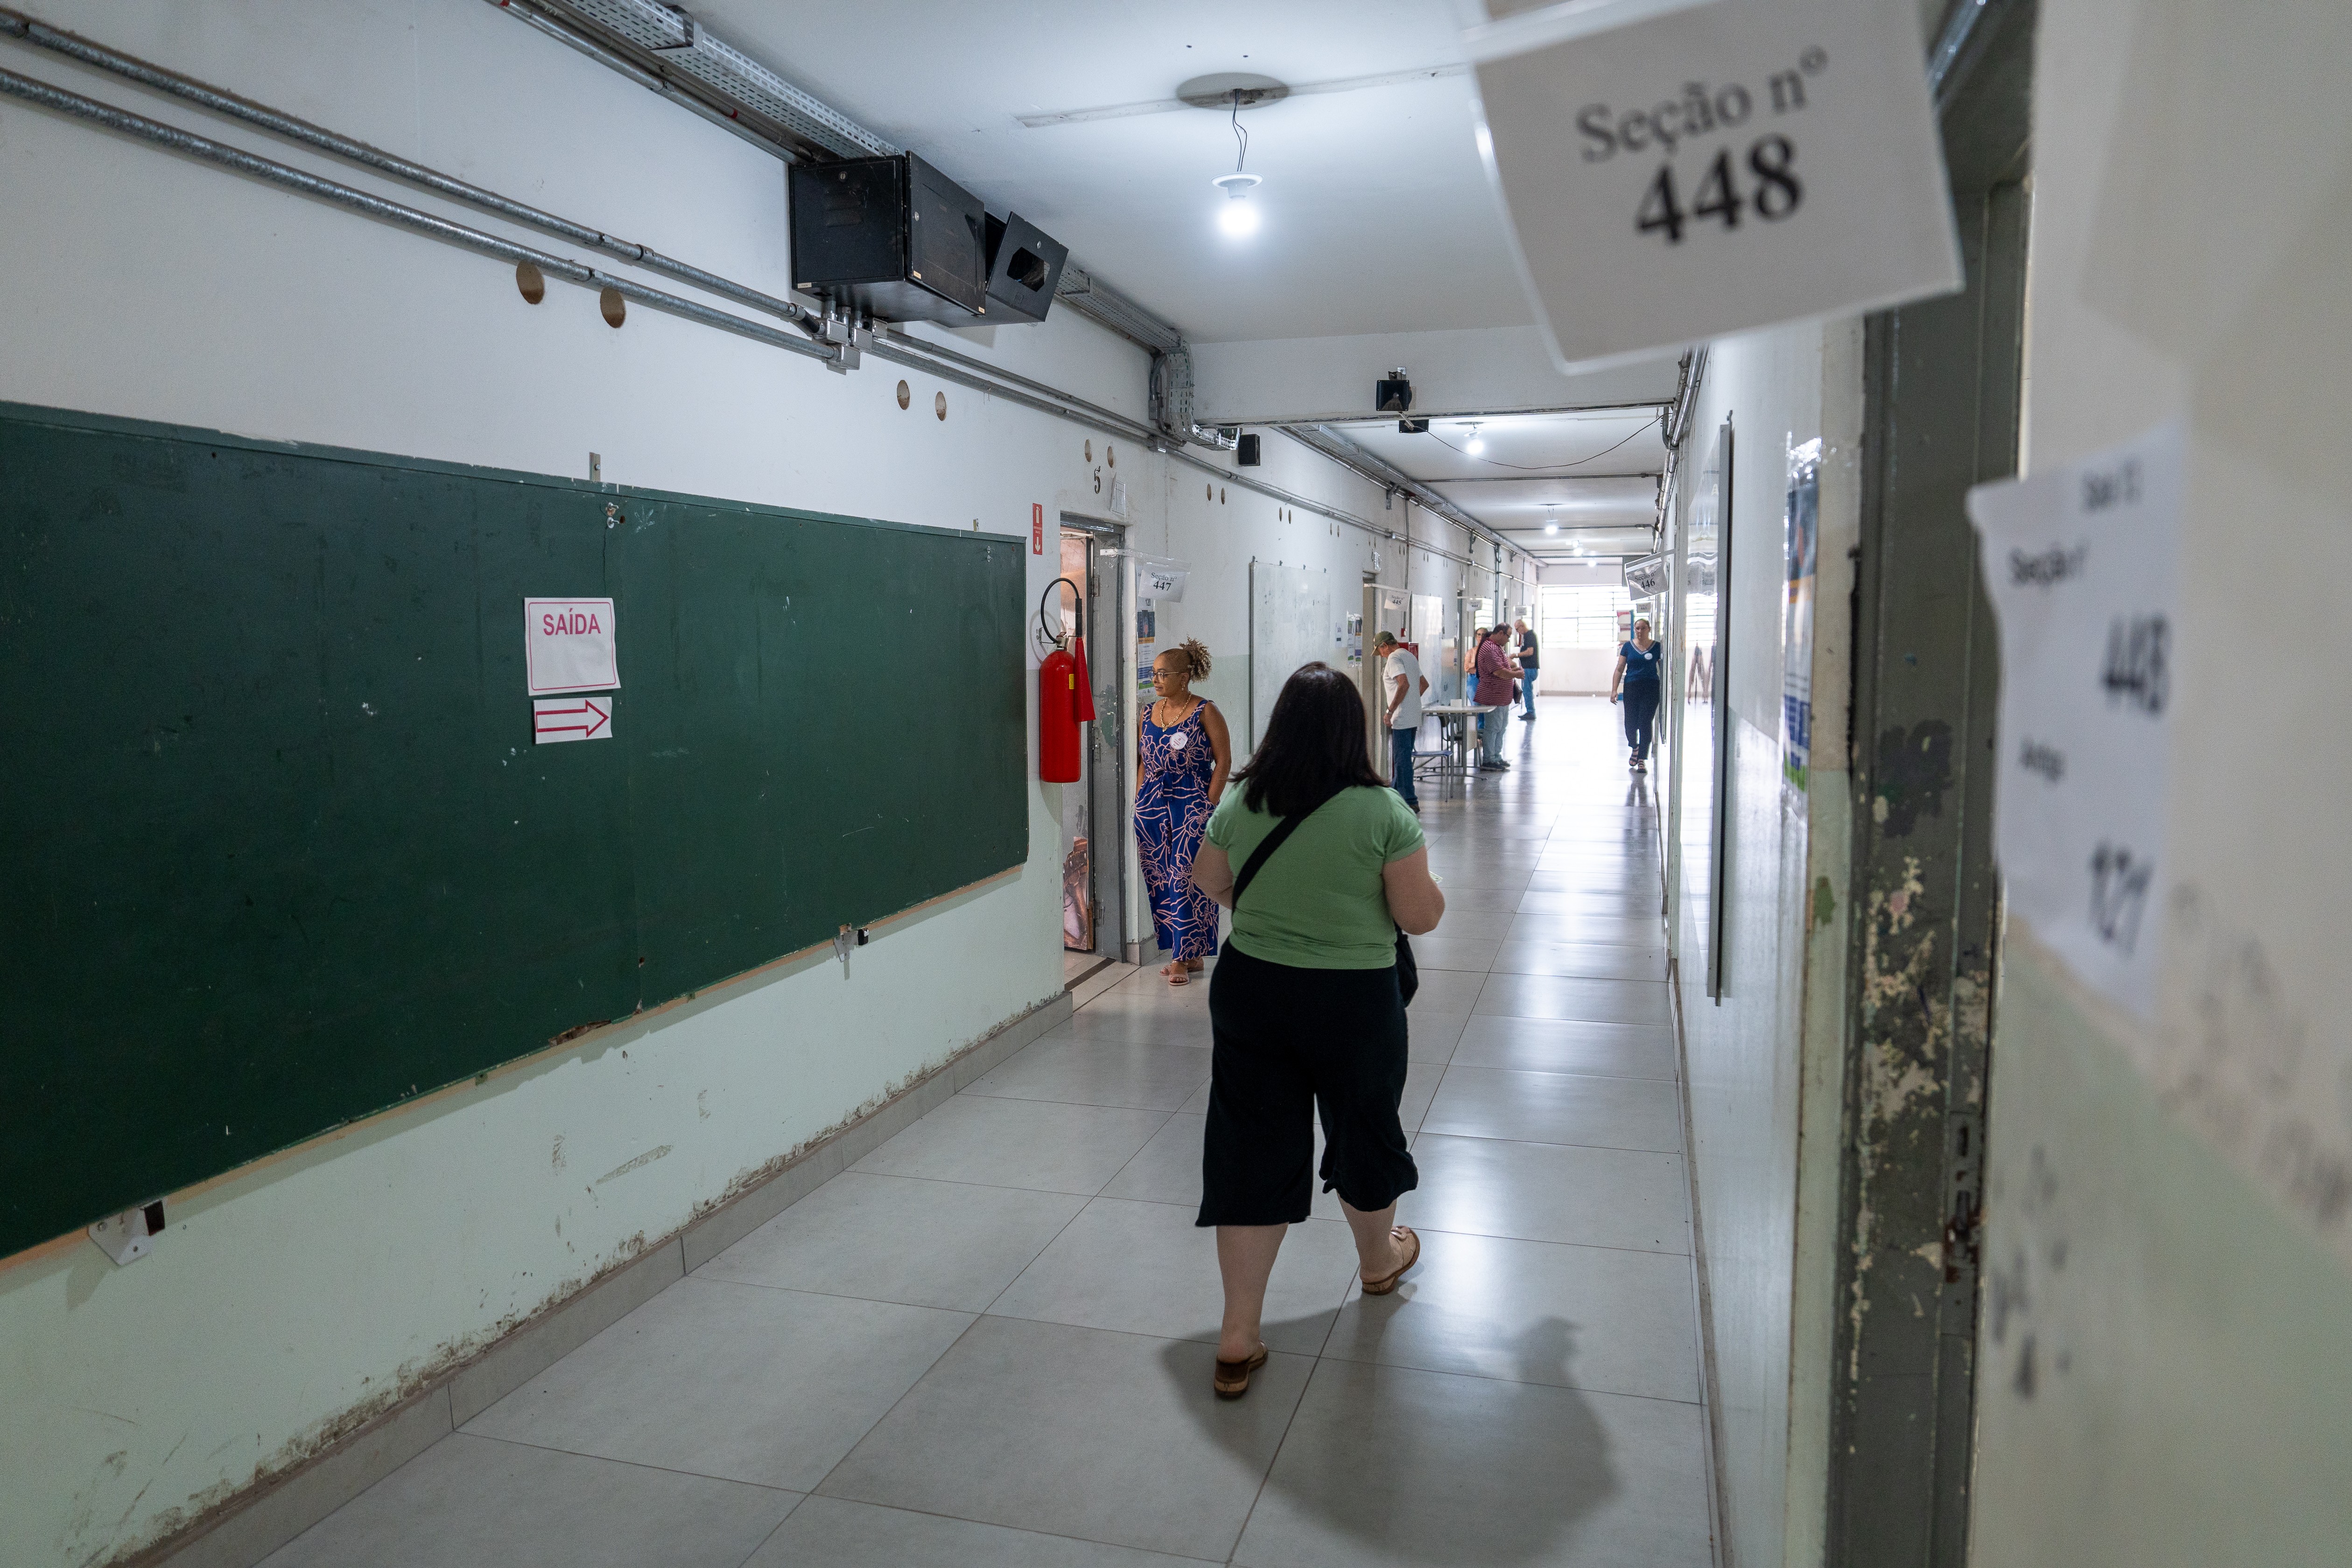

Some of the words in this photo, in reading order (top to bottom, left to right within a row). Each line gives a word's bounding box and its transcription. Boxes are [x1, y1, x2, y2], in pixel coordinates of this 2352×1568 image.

[1576, 81, 1752, 163] Seção
[1635, 132, 1805, 245] 448
[1094, 466, 1101, 494] 5
[1153, 581, 1172, 591] 447
[1635, 573, 1650, 582] Seção
[1641, 577, 1655, 589] 446
[543, 608, 601, 636] SAÍDA
